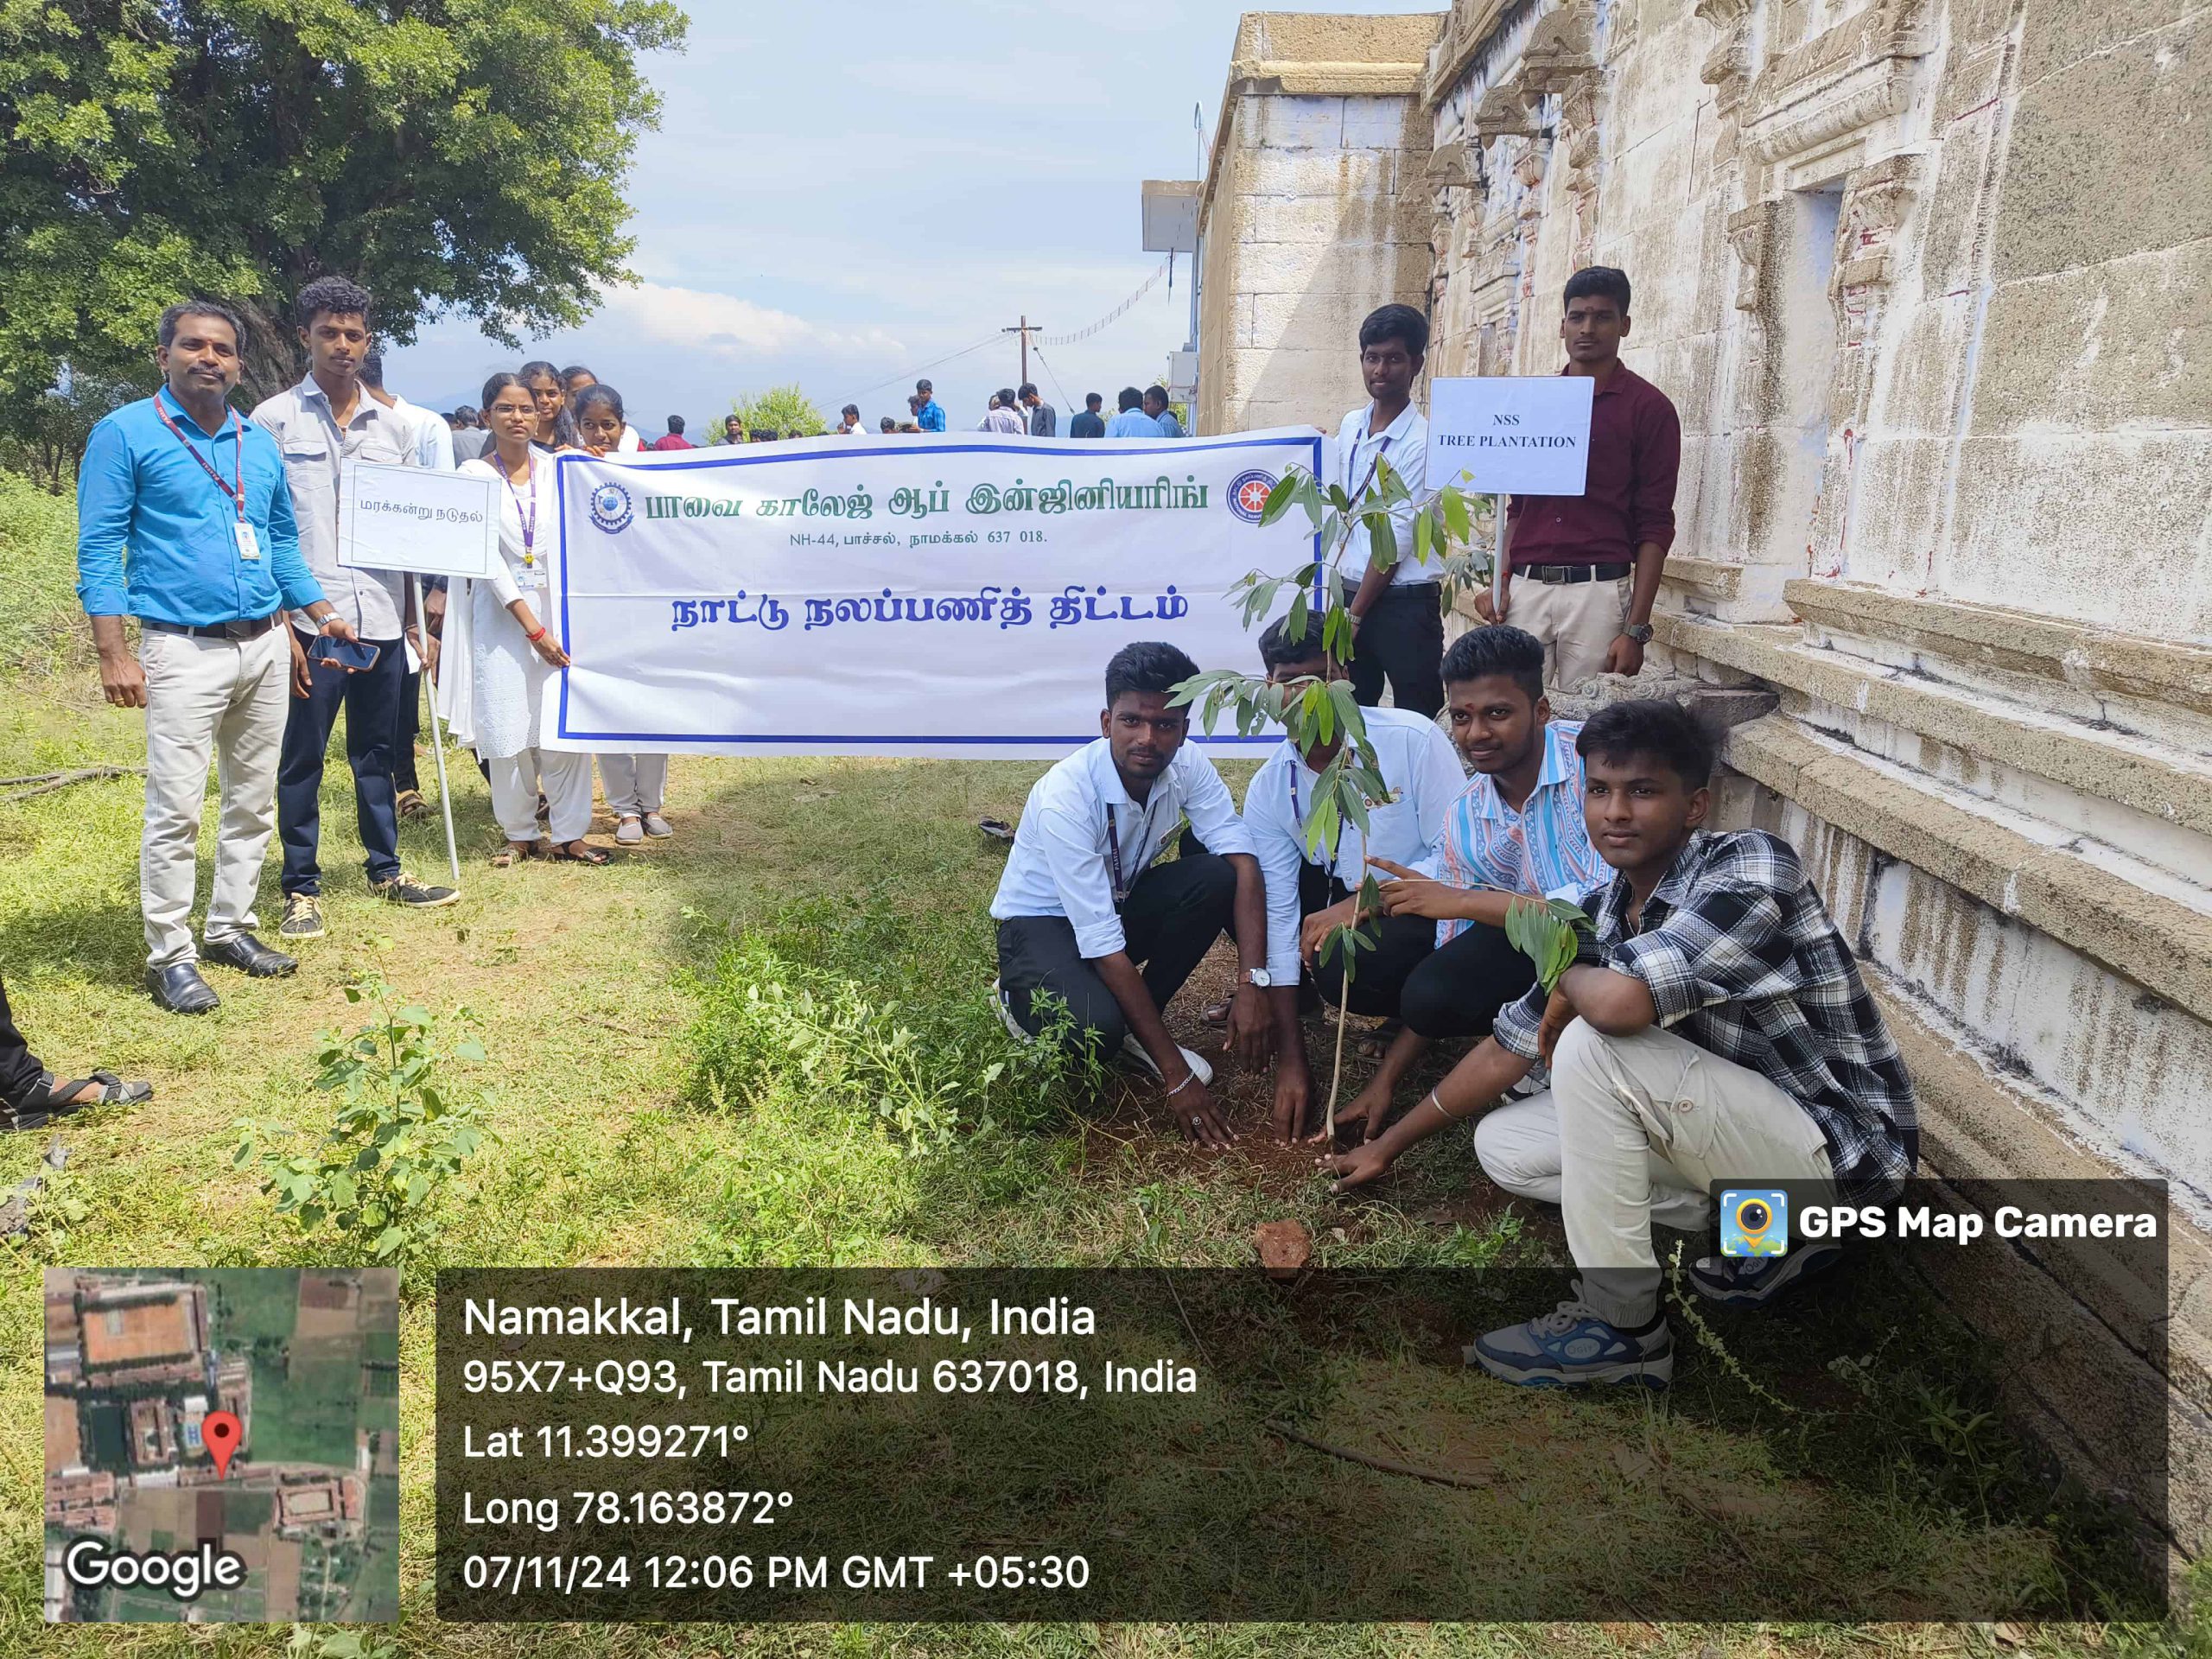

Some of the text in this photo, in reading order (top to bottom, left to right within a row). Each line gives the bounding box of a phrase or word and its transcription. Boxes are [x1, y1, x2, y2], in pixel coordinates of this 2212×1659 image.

[1493, 414, 1520, 426] NSS
[1438, 435, 1577, 448] TREE PLANTATION
[645, 475, 1209, 519] பாவை காலேஜ் ஆப் இன்ஜினியரிங்
[360, 499, 483, 524] மரக்கன்று நடுதல்
[790, 531, 1047, 548] NH-44, பாச்சல், நாமக்கல் 637 018.
[671, 585, 1188, 632] நாட்டு நலப்பணித் திட்டம்
